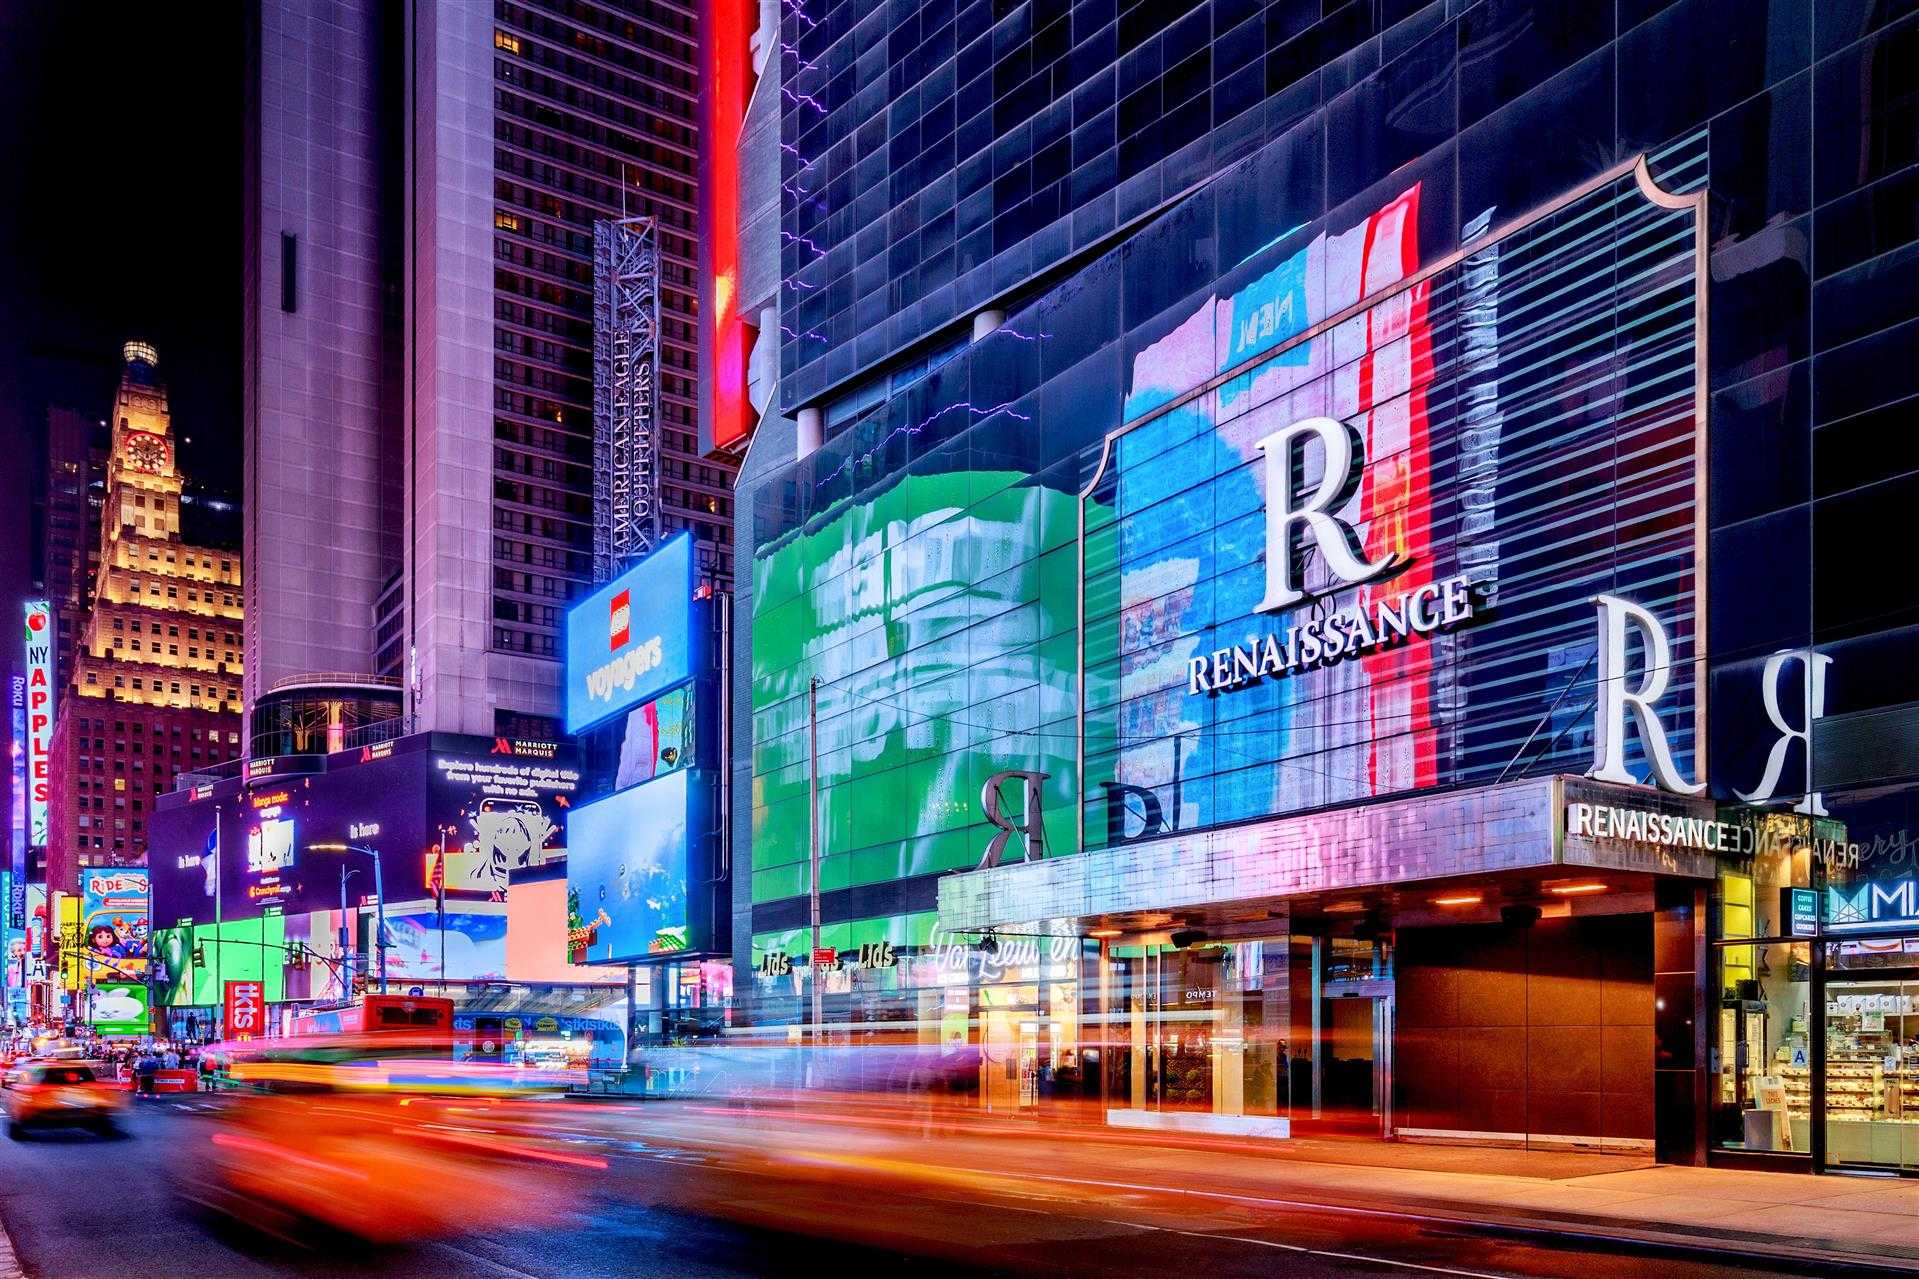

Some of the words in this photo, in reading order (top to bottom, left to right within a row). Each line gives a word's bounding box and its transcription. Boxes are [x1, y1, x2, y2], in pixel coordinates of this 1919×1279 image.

[613, 330, 630, 407] EAGLE
[633, 363, 650, 517] OUTFITTERS
[613, 417, 630, 551] AMERICAN
[1253, 417, 1400, 614] R
[29, 646, 48, 664] NY
[1188, 574, 1474, 696] RENAISSANCE
[13, 676, 25, 707] Roku
[1584, 594, 1707, 796] R
[31, 668, 48, 802] APPLES
[515, 740, 558, 750] MARRIOTT
[515, 747, 554, 757] MARQUIS
[504, 786, 519, 797] no
[1571, 803, 1730, 852] RENAISSANCE
[1872, 881, 1919, 919] MI
[760, 951, 790, 977] Lids
[859, 941, 894, 969] Lids
[234, 983, 260, 1029] tkts
[1794, 1050, 1805, 1063] A
